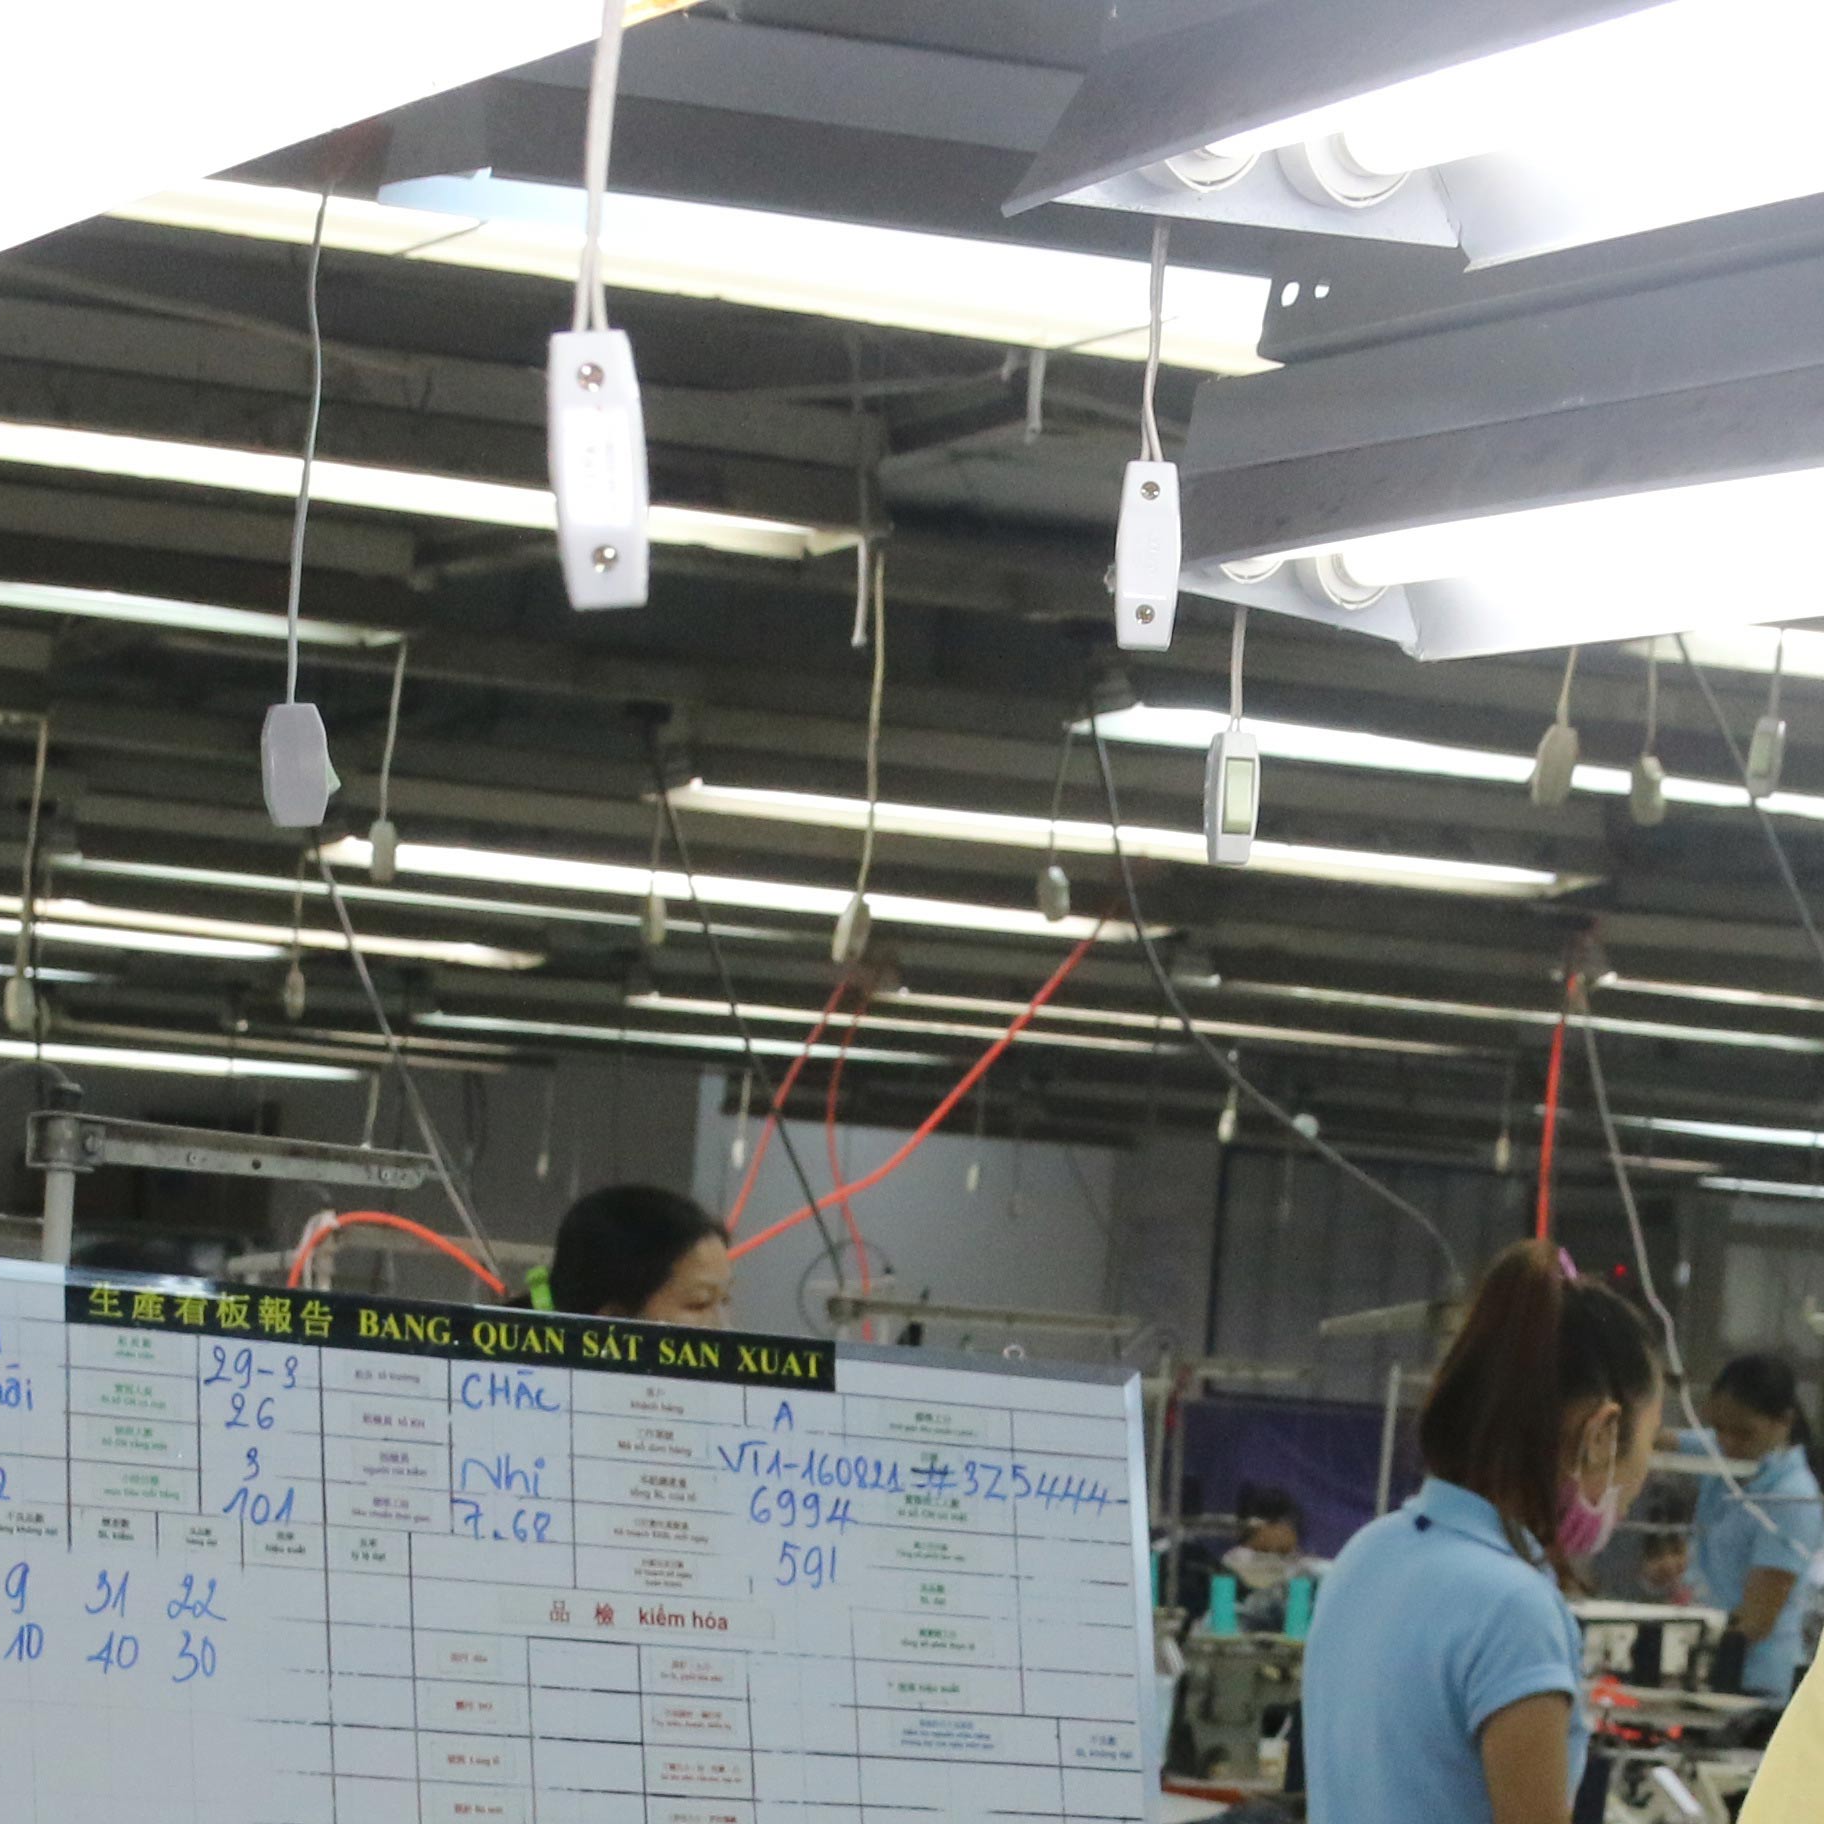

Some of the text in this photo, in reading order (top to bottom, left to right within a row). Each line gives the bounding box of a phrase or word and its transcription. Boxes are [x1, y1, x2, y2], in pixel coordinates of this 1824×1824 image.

[89, 1281, 333, 1338] 生產看板報告
[472, 1320, 566, 1355] QUAN
[659, 1340, 720, 1368] SAN
[737, 1348, 824, 1379] XUAT
[225, 1397, 276, 1430] 26
[223, 1487, 295, 1527] 101
[5, 1561, 30, 1614] 9
[167, 1573, 228, 1622] 22
[776, 1541, 837, 1590] 591
[692, 1610, 728, 1632] hóa
[4, 1623, 45, 1663] 10
[86, 1630, 139, 1675] 40
[172, 1630, 217, 1683] 30
